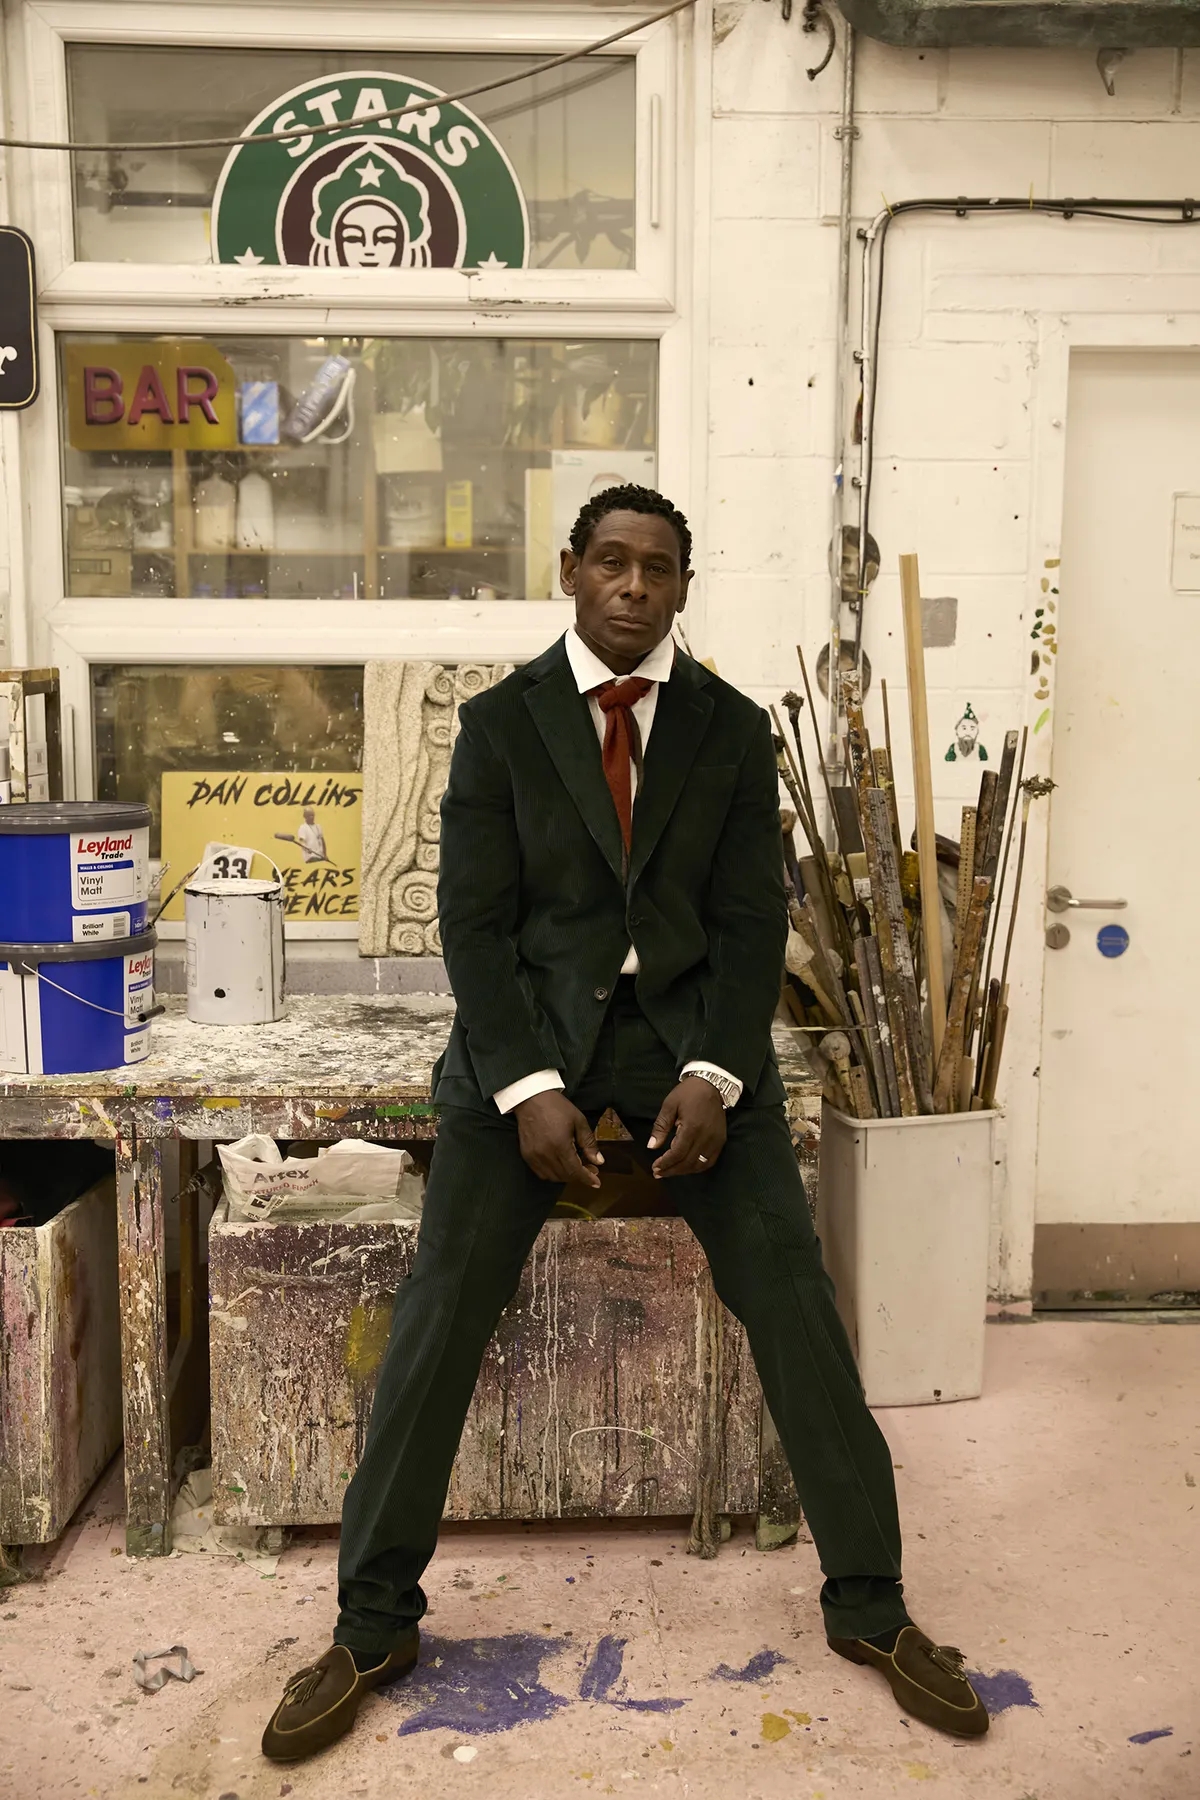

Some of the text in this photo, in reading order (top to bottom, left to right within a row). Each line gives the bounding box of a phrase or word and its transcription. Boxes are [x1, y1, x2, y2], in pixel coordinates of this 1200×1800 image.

[272, 87, 480, 167] STARS
[83, 365, 220, 425] BAR
[187, 776, 248, 809] DAN
[77, 834, 133, 857] Leyland
[101, 852, 124, 860] Trade
[212, 856, 248, 879] 33
[80, 876, 104, 886] Vinyl
[272, 867, 356, 893] YEARS
[80, 886, 103, 895] Matt
[82, 922, 104, 930] Brilliant
[130, 993, 144, 1005] Vinyl
[130, 1005, 144, 1015] Matt
[254, 1169, 310, 1184] Artex
